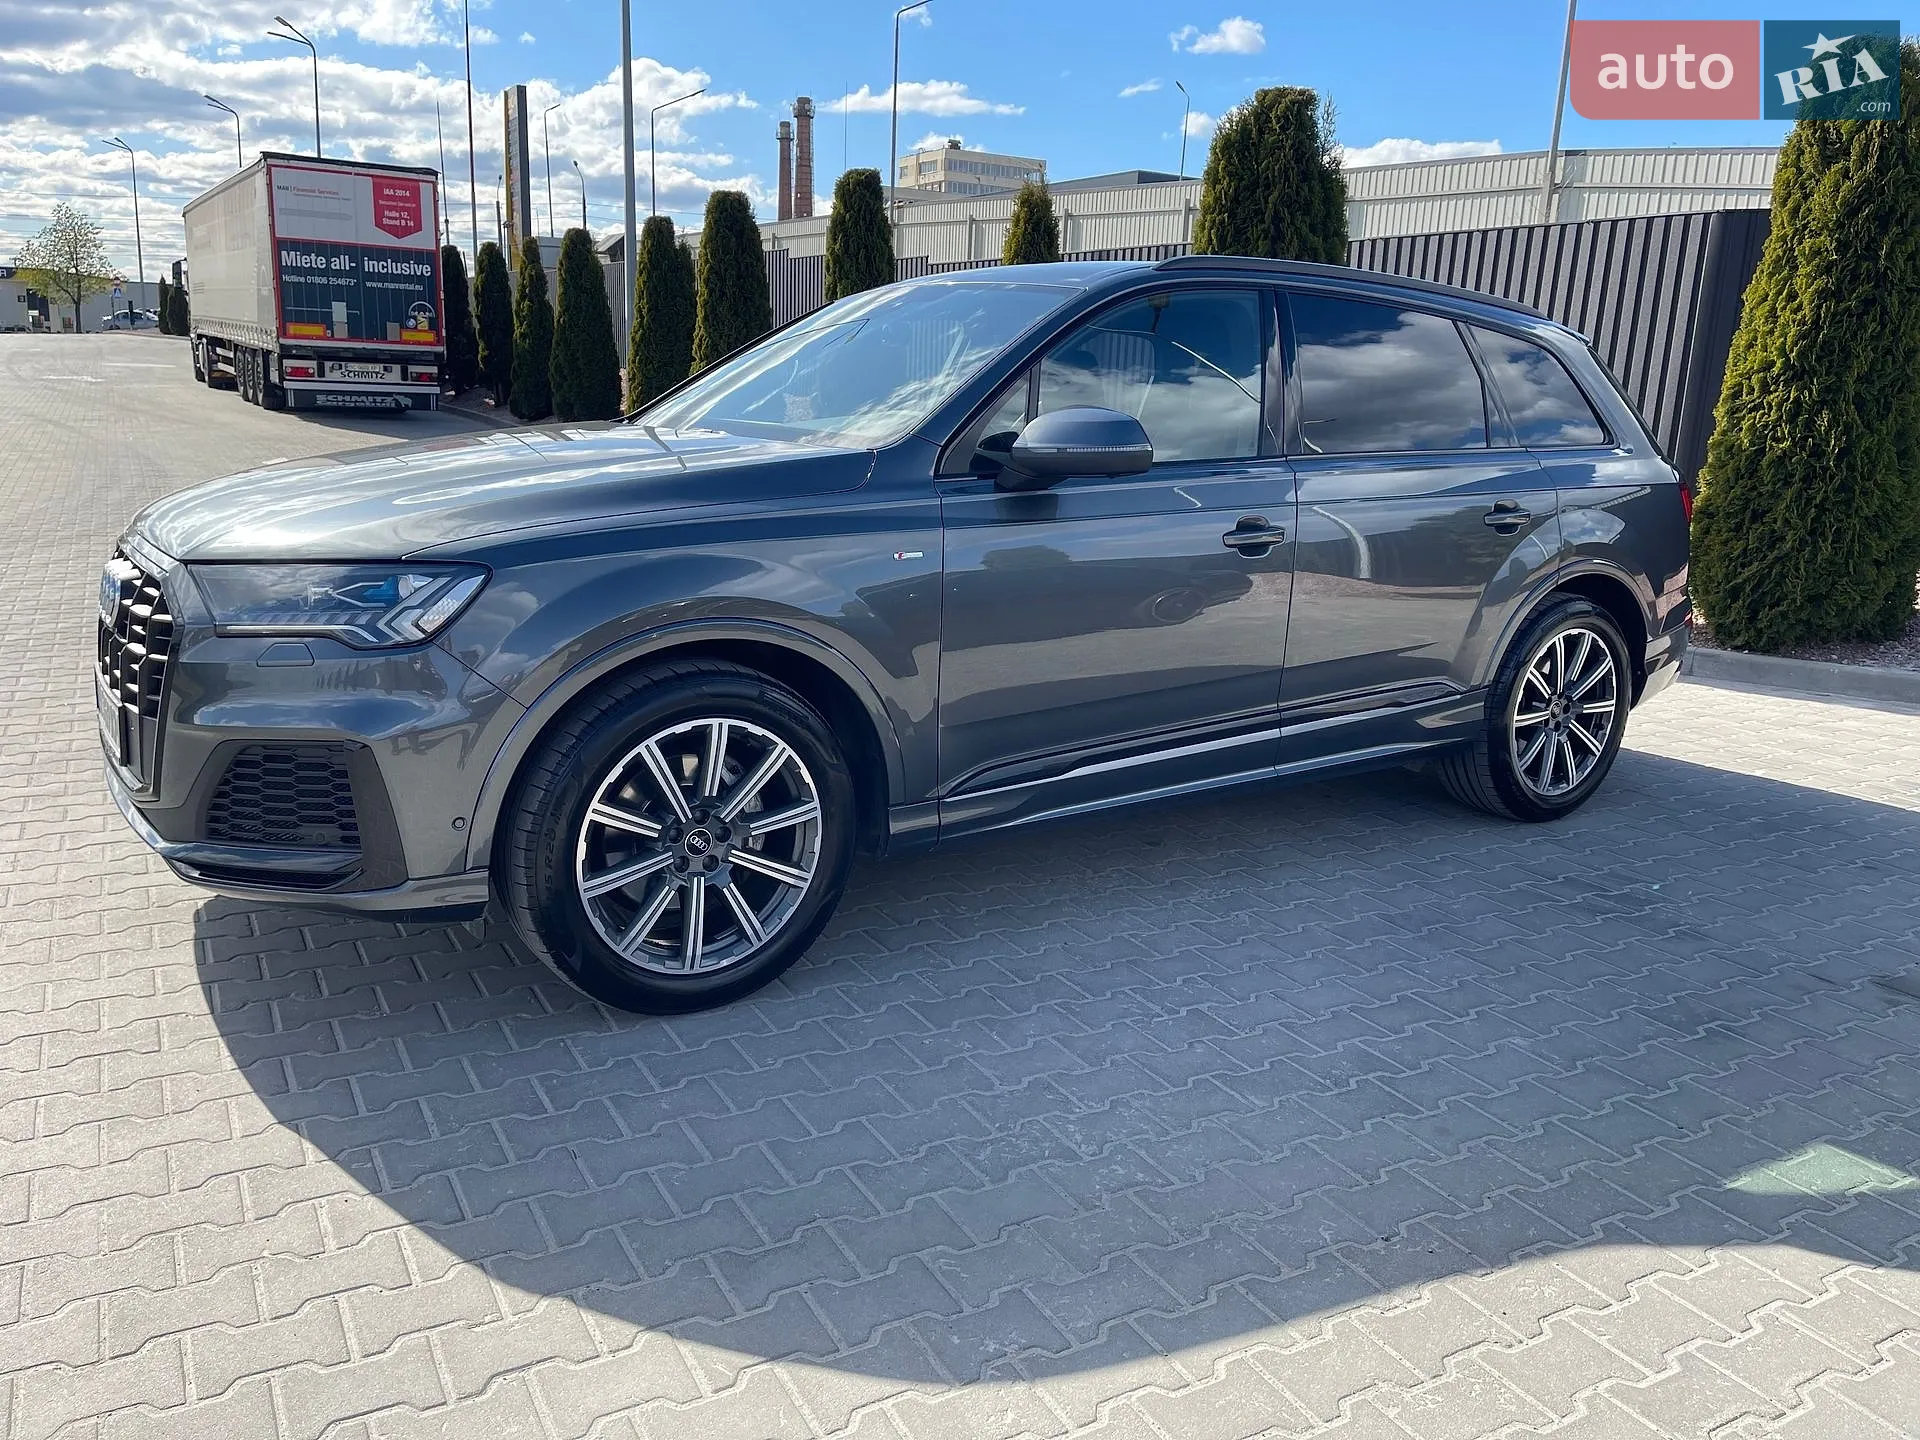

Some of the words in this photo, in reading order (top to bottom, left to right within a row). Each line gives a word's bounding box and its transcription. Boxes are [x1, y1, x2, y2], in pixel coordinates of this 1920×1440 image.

[382, 218, 400, 226] Stand
[281, 250, 327, 269] Miete
[330, 254, 356, 270] all-
[363, 257, 431, 276] inclusive
[282, 274, 305, 283] Hotline
[365, 281, 423, 291] www.manrental.eu
[340, 370, 385, 379] SCHMITZ
